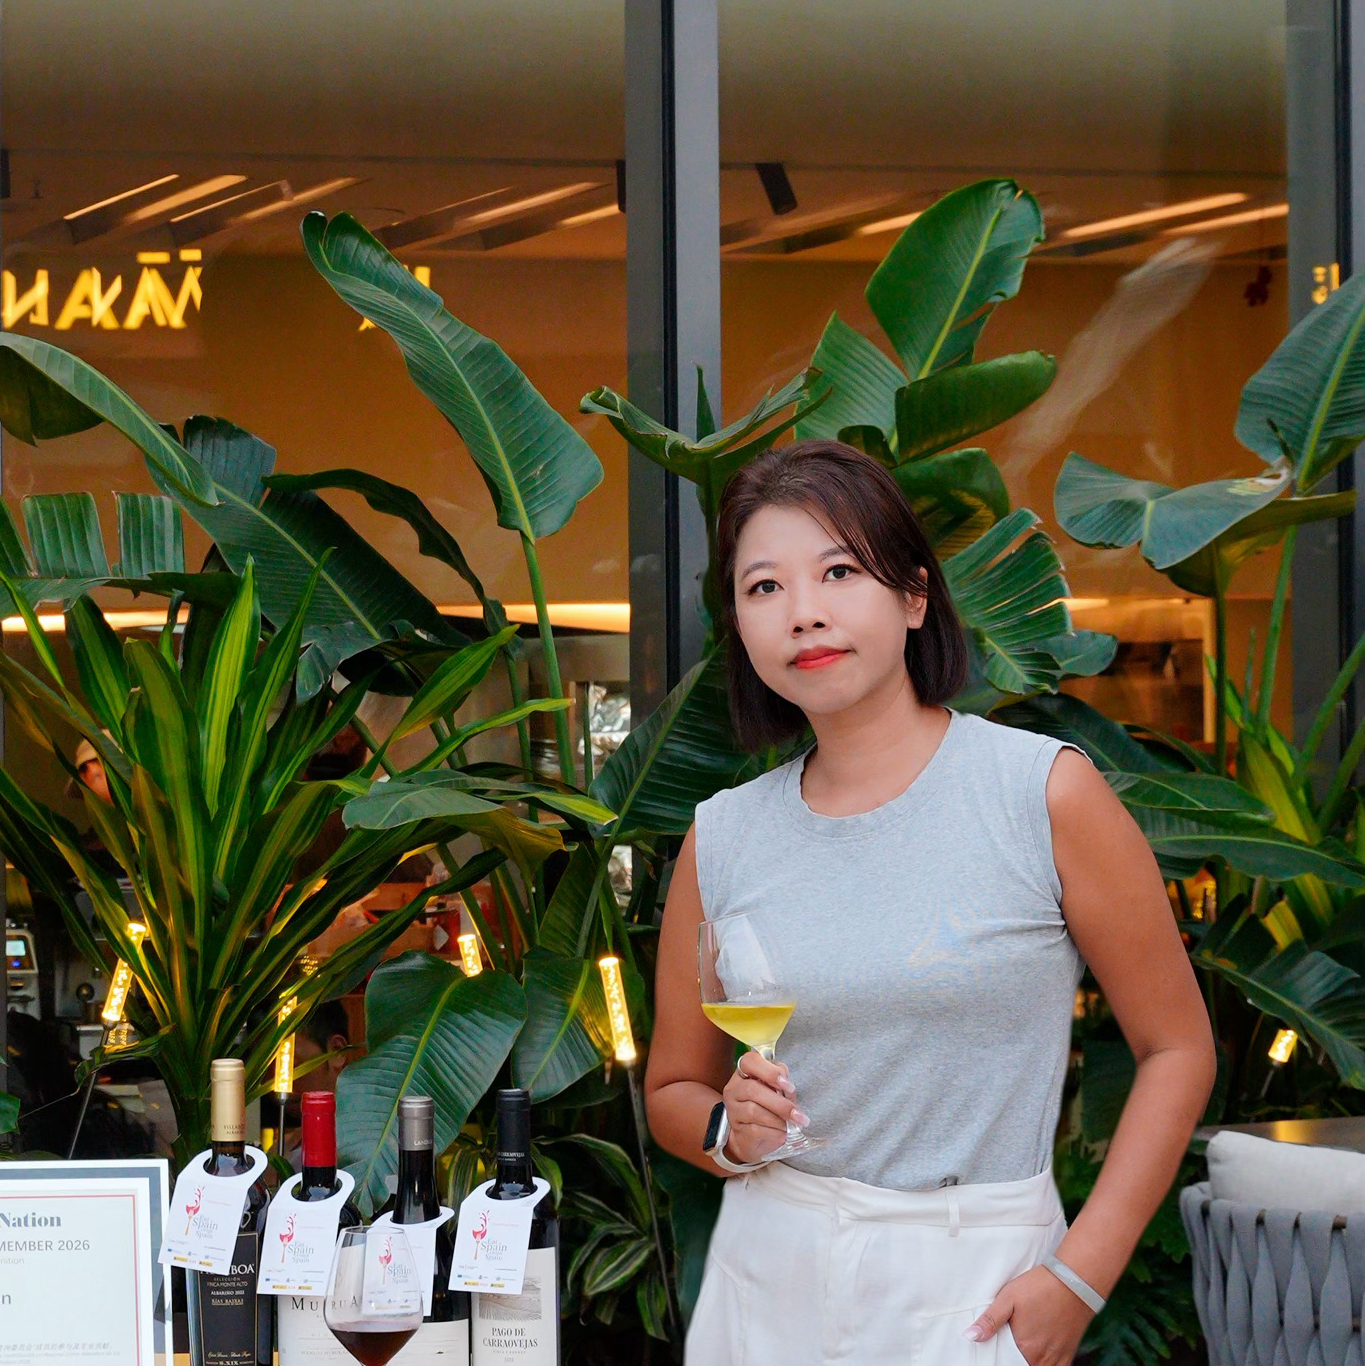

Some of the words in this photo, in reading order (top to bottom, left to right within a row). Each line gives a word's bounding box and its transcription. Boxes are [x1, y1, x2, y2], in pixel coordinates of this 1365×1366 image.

[192, 1217, 218, 1231] Spain
[195, 1231, 213, 1240] Spain
[58, 1239, 90, 1251] 2026
[288, 1244, 314, 1255] Spain
[480, 1241, 507, 1253] Spain
[485, 1254, 502, 1262] Spain
[387, 1265, 411, 1277] Spain
[492, 1327, 512, 1337] PAGO
[515, 1328, 526, 1337] DE
[482, 1338, 539, 1349] CARRAOVEJAS
